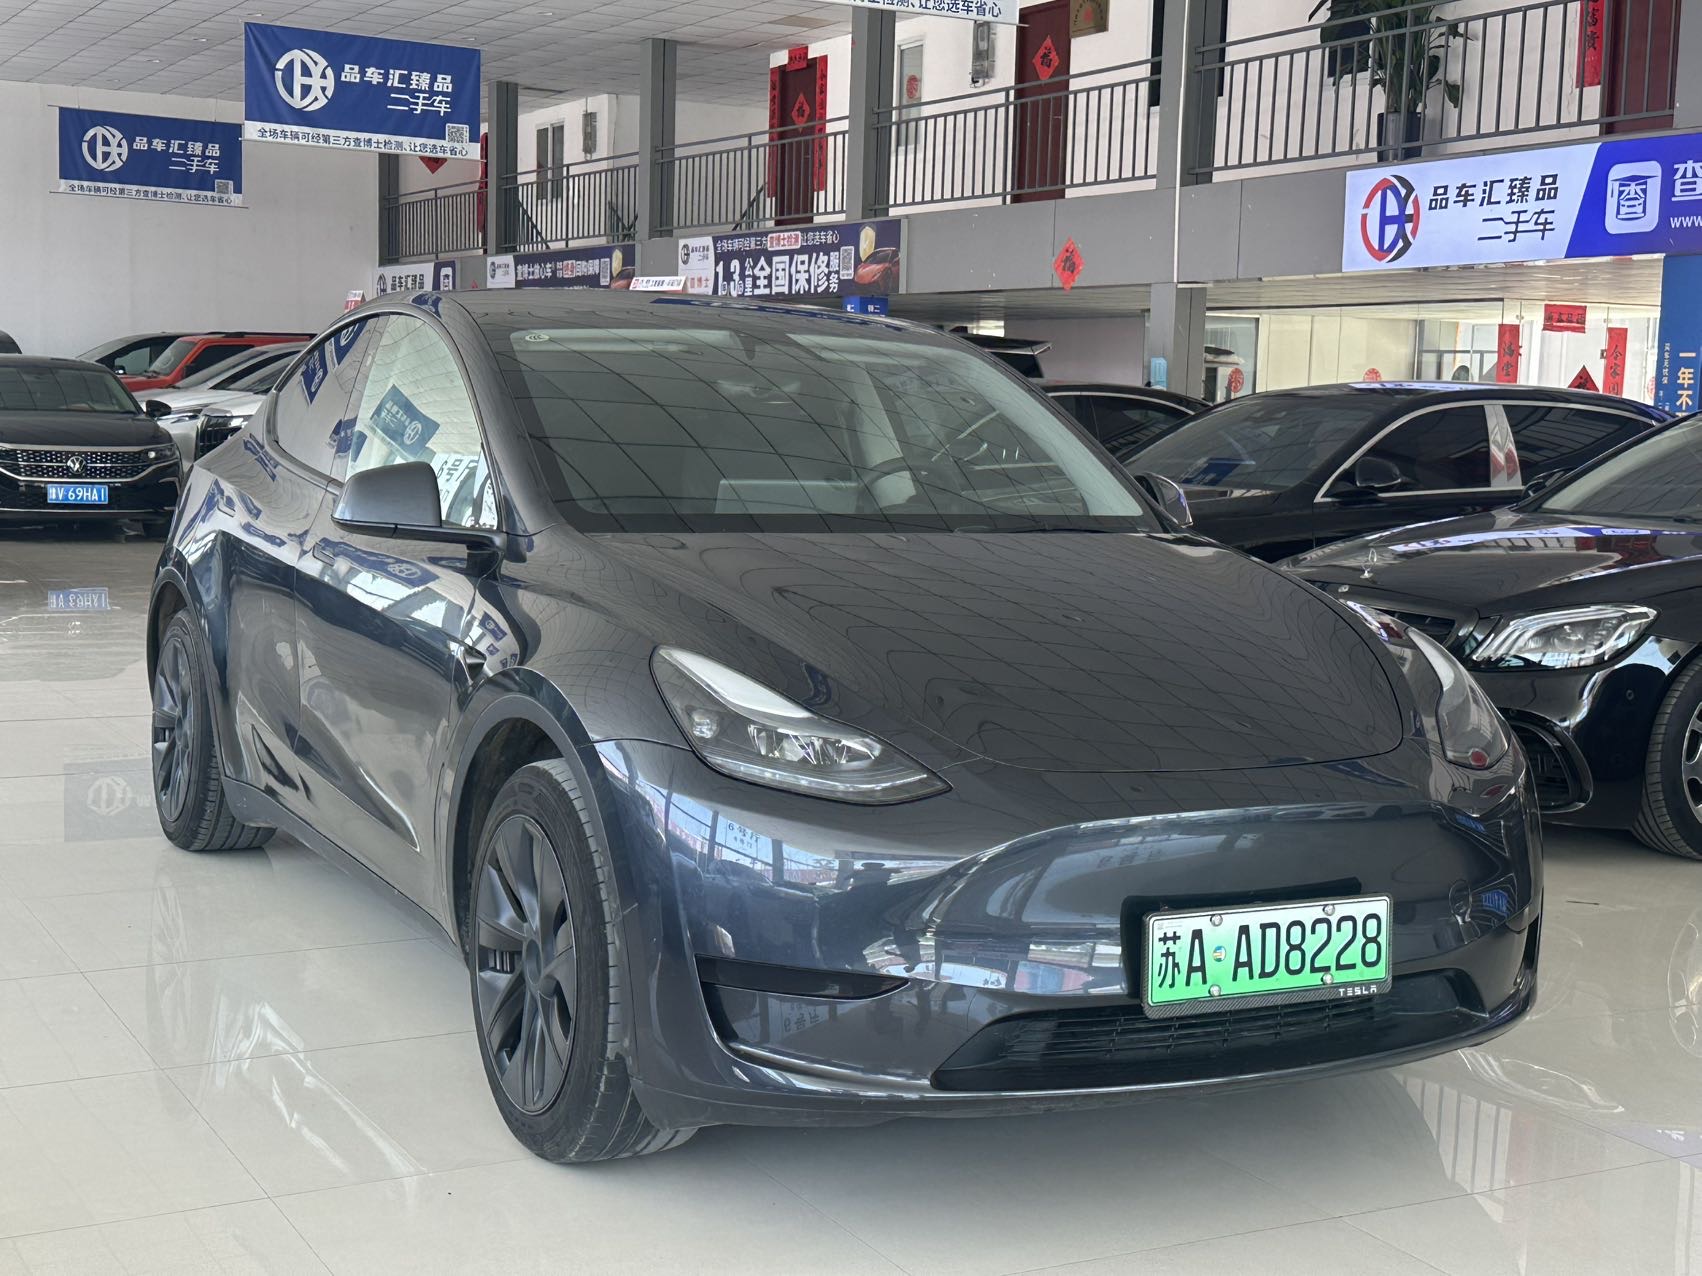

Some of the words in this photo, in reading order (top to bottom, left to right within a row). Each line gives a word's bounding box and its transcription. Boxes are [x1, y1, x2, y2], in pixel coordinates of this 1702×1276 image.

[340, 64, 453, 92] 品车汇臻品
[387, 92, 452, 117] 二手车
[132, 136, 220, 157] 品车汇臻品
[168, 156, 220, 175] 二手车
[1427, 173, 1559, 211] 品车汇臻品
[1671, 160, 1702, 202] 查
[1477, 208, 1556, 243] 二手车
[1231, 912, 1383, 983] AD8228
[1338, 984, 1378, 998] TESLA
